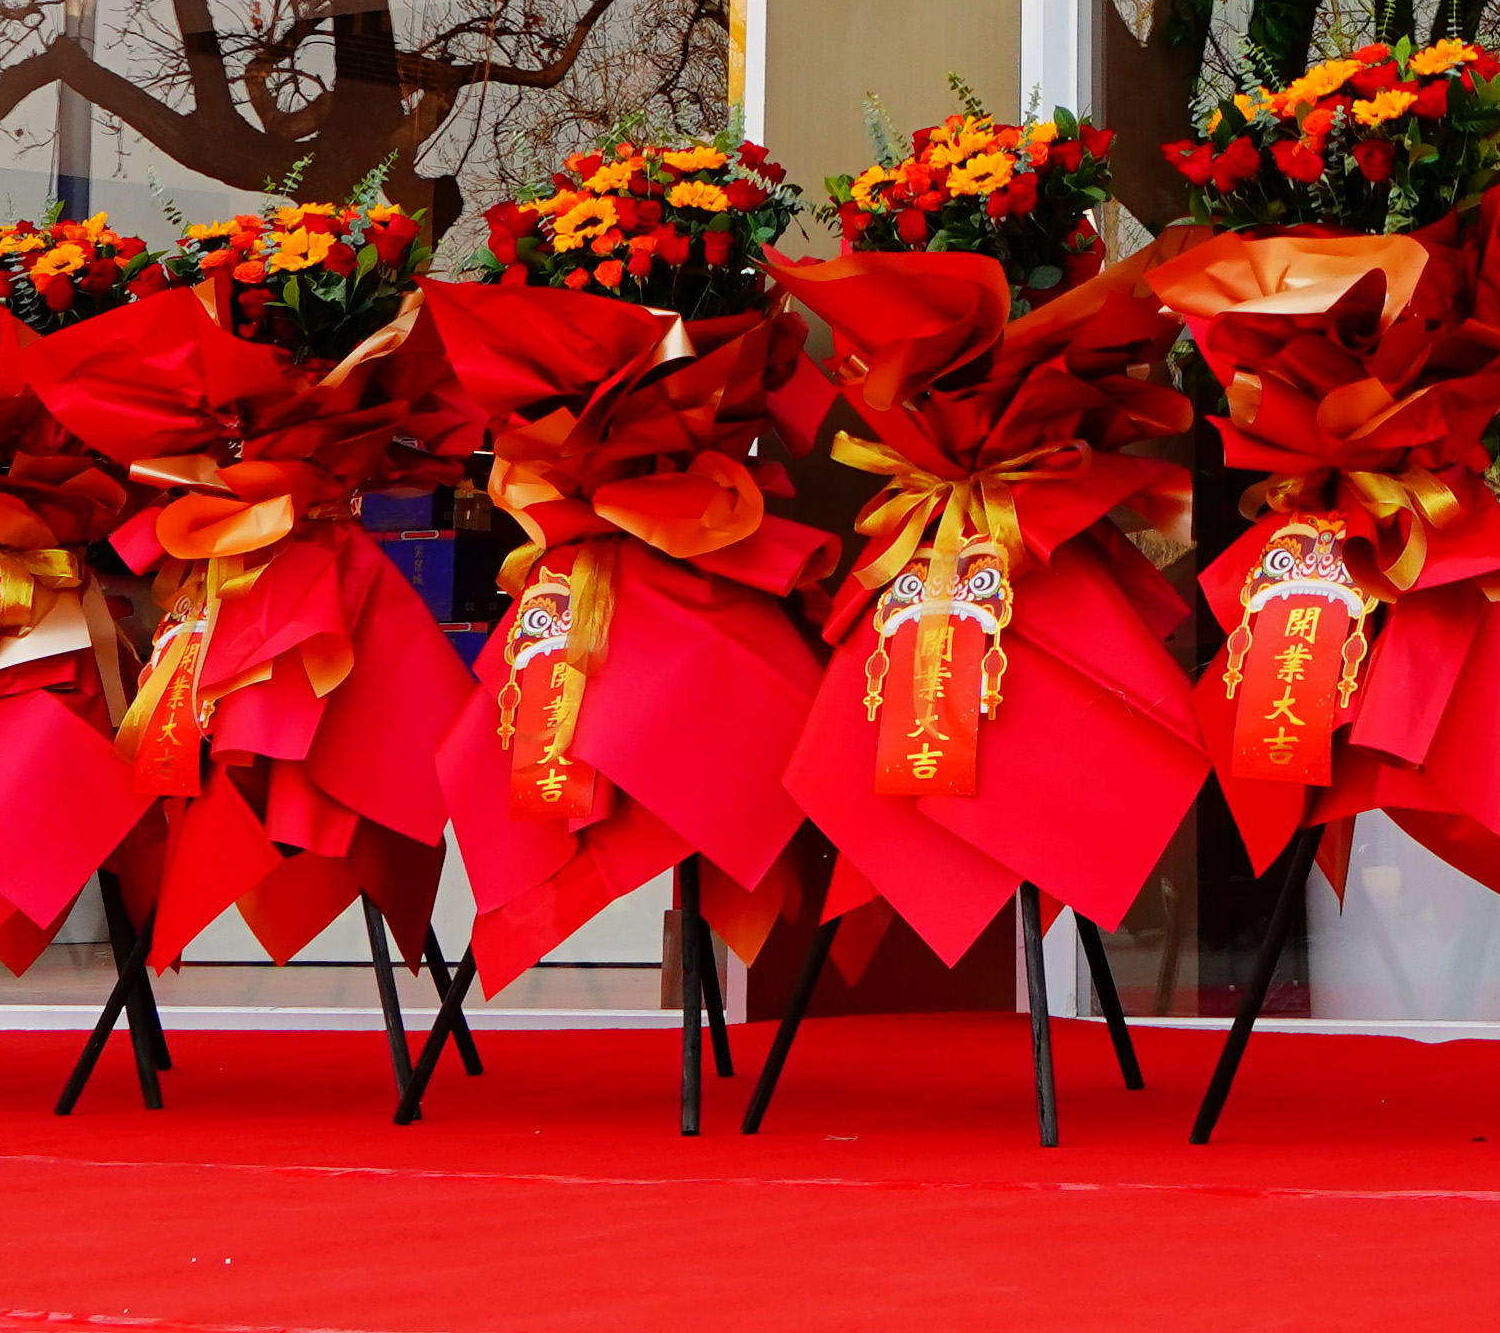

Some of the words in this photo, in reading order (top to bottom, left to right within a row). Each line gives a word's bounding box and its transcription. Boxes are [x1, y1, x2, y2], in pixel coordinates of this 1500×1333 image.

[906, 626, 956, 779] 開業大吉
[1263, 606, 1322, 765] 開業大吉
